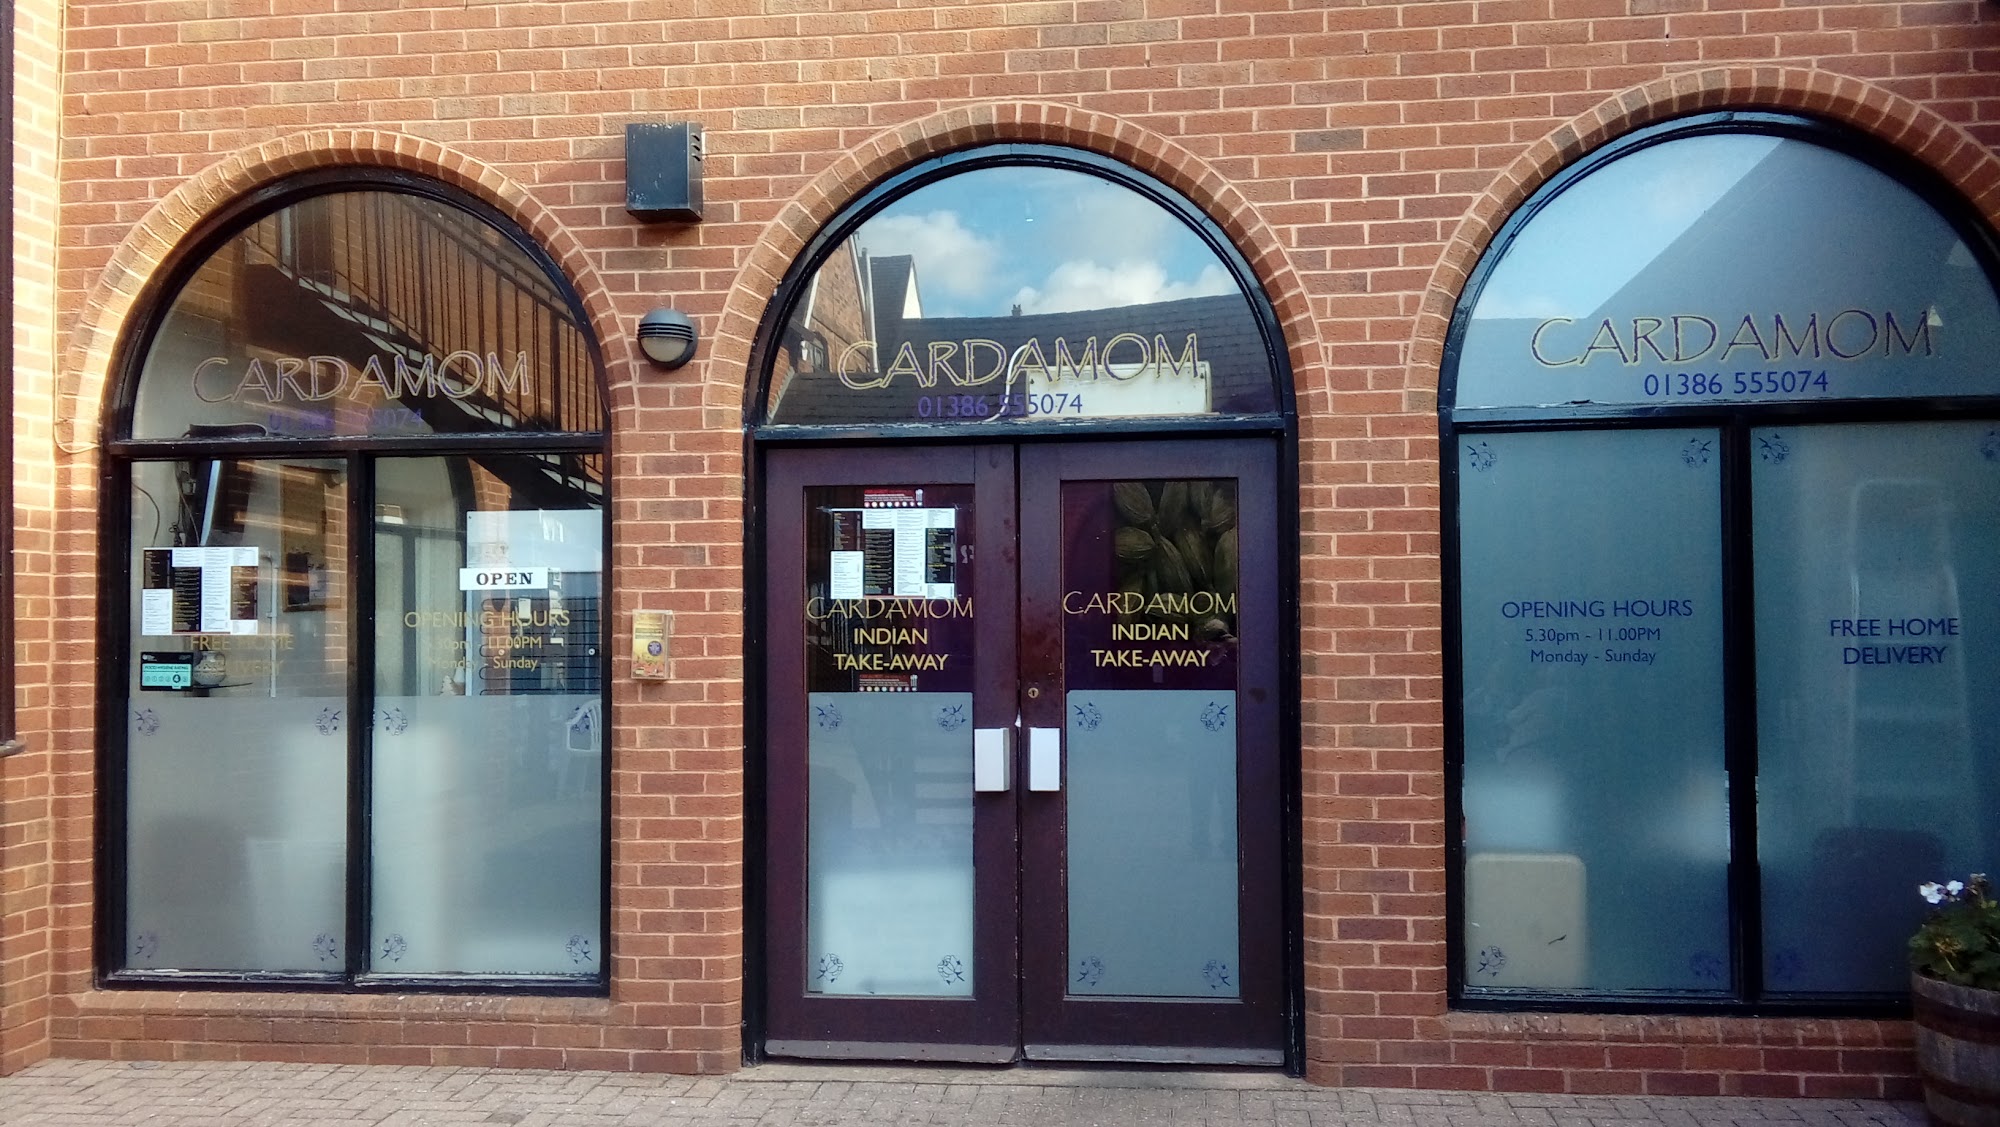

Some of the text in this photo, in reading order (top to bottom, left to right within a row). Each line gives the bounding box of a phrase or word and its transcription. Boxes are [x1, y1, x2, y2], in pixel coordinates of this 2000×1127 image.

[1530, 309, 1934, 367] CARDAMOM
[838, 333, 1198, 389] CARDAMOM
[192, 350, 530, 403] CARDAMOM
[1644, 371, 1829, 396] 01386 555074
[917, 393, 1083, 418] 01386 555074
[476, 572, 534, 586] OPEN
[806, 597, 973, 619] CARDAMOM
[1063, 591, 1237, 614] CARDAMOM
[1502, 600, 1693, 618] OPENING HOURS
[404, 610, 570, 628] OPENING HOURS
[1830, 618, 1960, 636] FREE HOME
[854, 628, 928, 645] INDIAN
[1112, 624, 1189, 640] INDIAN
[1525, 628, 1580, 645] 5.30pm
[1599, 628, 1661, 641] 11.00PM
[189, 635, 231, 651] FREE
[493, 656, 538, 672] Sunday
[833, 653, 949, 671] TAKE-AWAY
[1091, 650, 1211, 667] TAKE-AWAY
[1530, 649, 1588, 666] Monday
[1605, 649, 1656, 666] Sunday
[1843, 646, 1947, 665] DELIVERY
